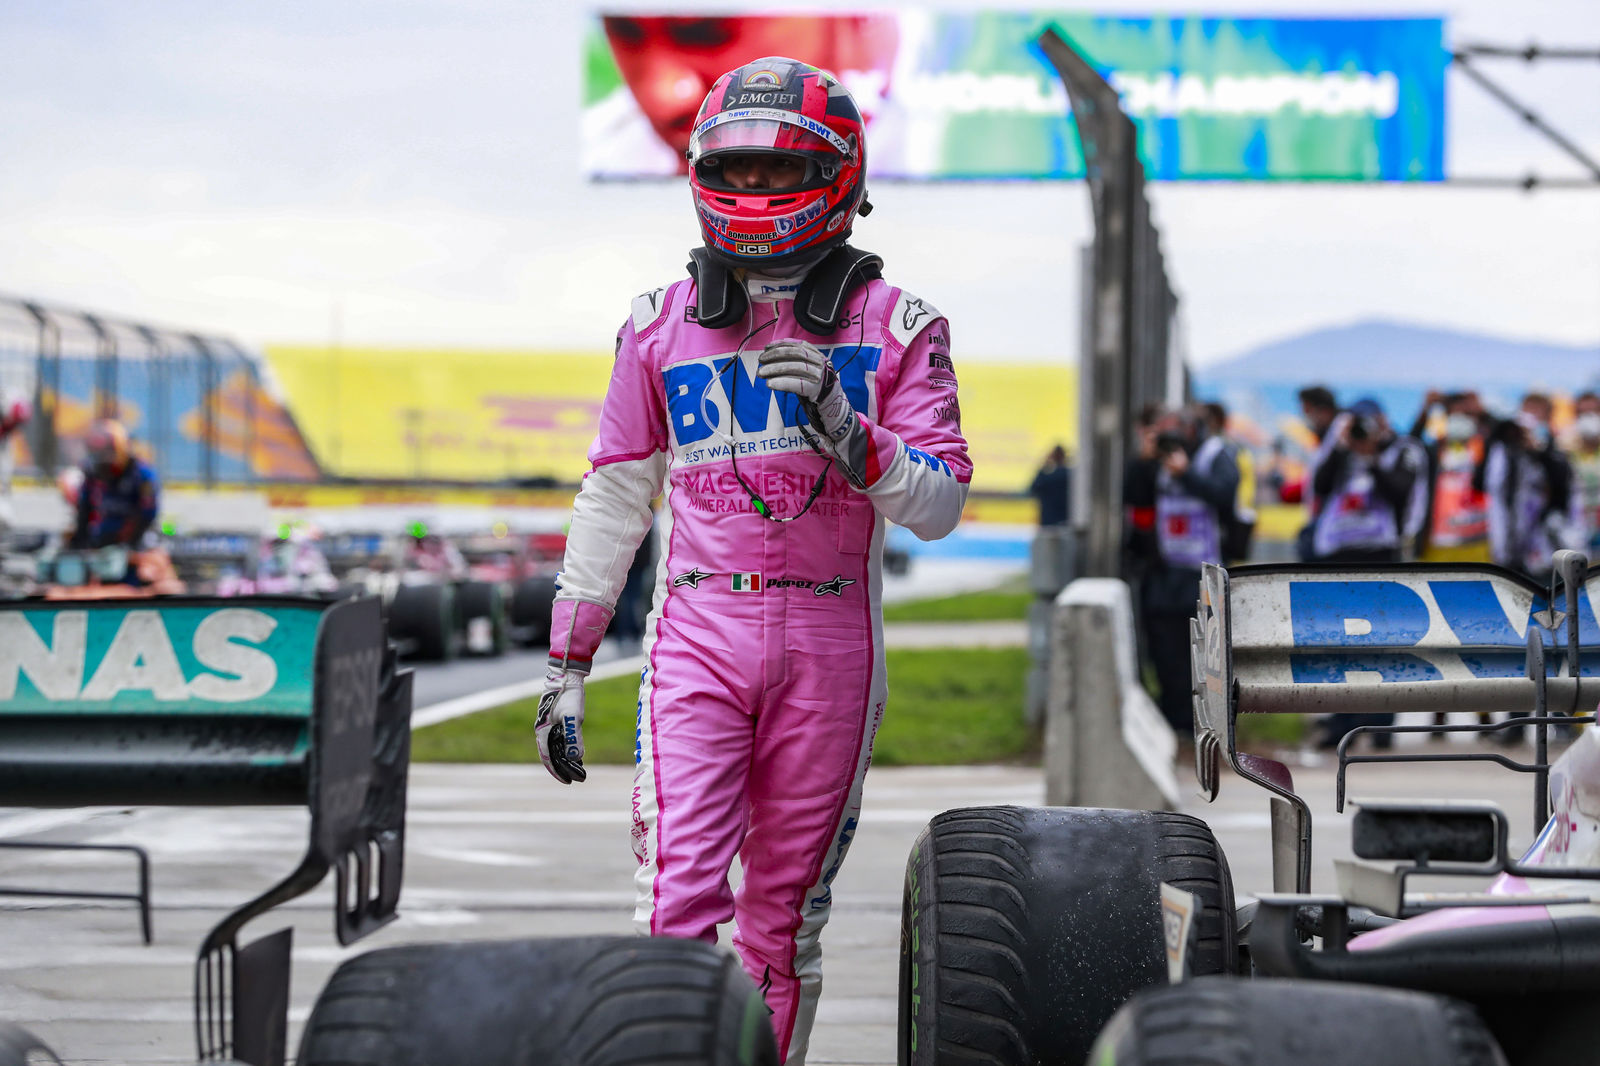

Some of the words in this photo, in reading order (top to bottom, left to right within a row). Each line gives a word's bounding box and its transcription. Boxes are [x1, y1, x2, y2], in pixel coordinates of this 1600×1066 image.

[739, 93, 798, 105] EMCJET
[700, 116, 719, 133] BWT
[808, 121, 831, 139] BWT
[728, 231, 778, 241] BOMBARDIER
[738, 244, 769, 254] JCB
[662, 346, 882, 446] BWT
[707, 441, 757, 457] WATER
[684, 471, 849, 500] MAGNESIUM
[688, 496, 788, 514] MINERALIED
[564, 716, 577, 744] BWT
